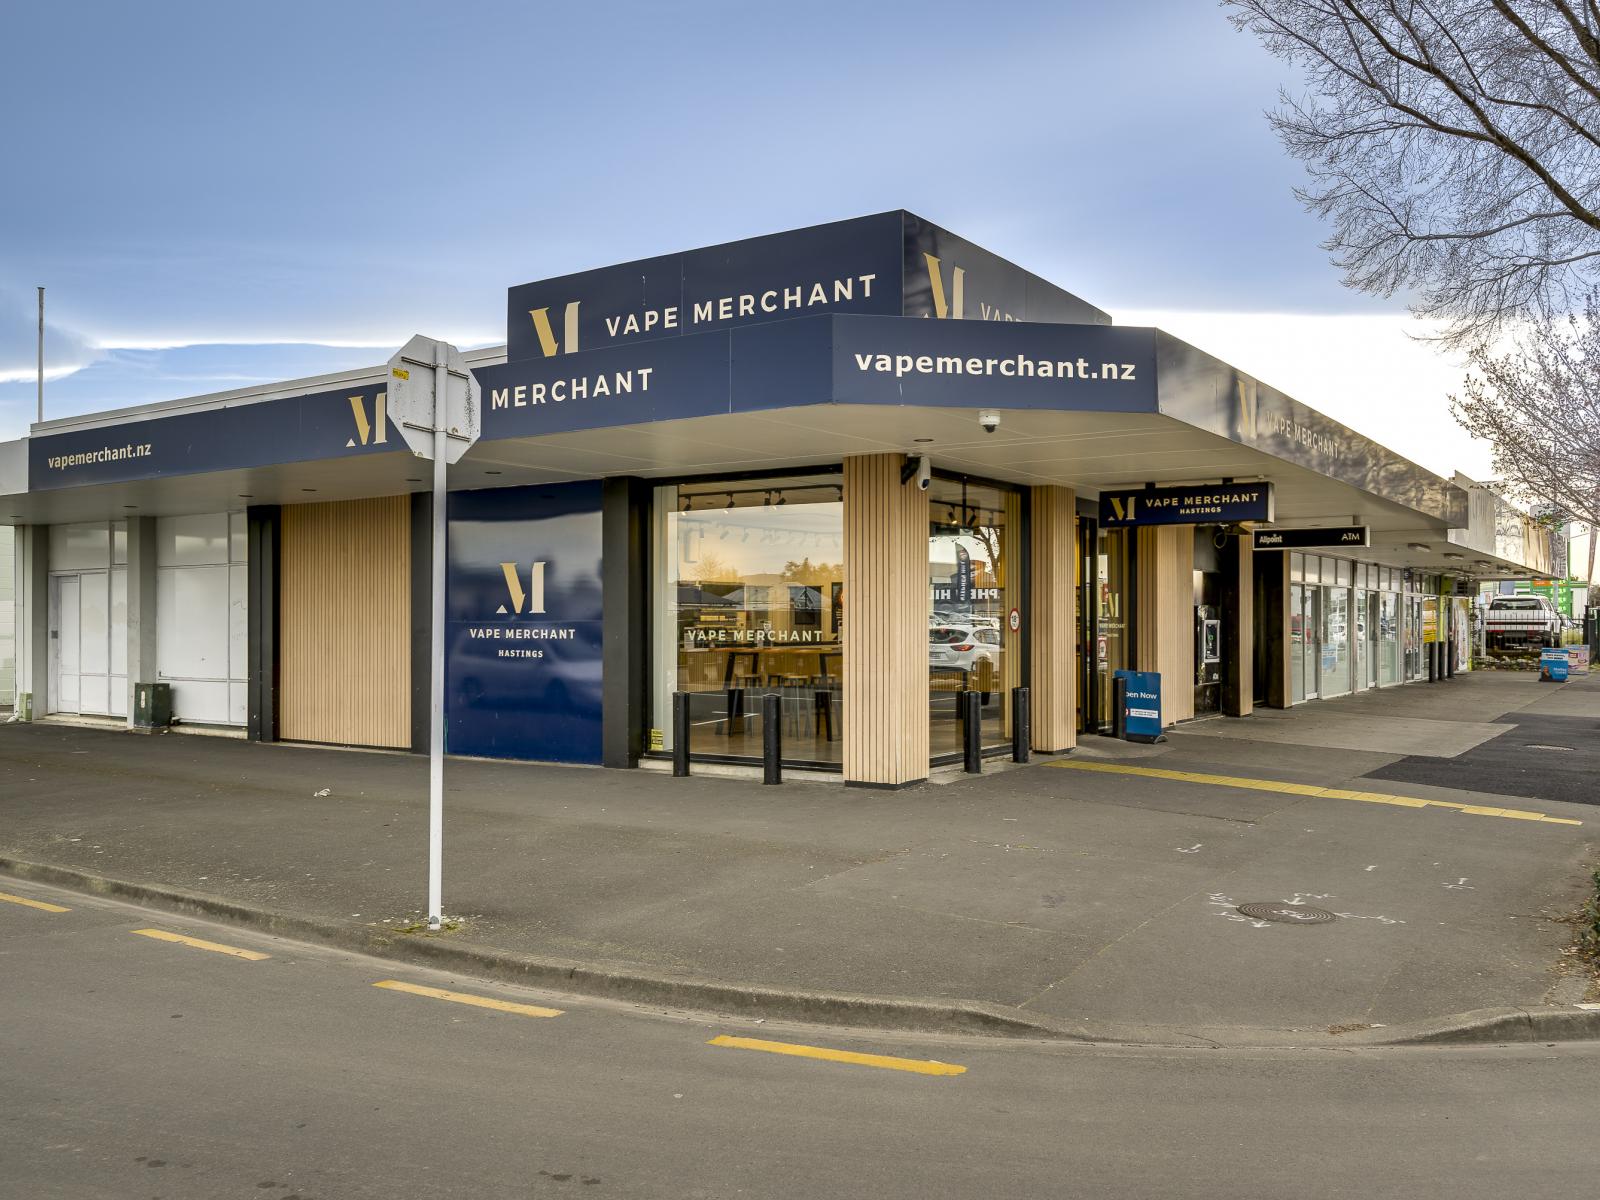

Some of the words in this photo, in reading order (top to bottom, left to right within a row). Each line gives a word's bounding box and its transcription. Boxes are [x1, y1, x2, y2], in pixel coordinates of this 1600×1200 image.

[605, 306, 679, 337] VAPE
[693, 273, 876, 325] MERCHANT
[854, 353, 1136, 381] vapemerchant.nz
[491, 367, 654, 411] MERCHANT
[1266, 410, 1292, 438] VAPE
[1294, 423, 1340, 459] MERCHANT
[48, 441, 152, 472] vapemerchant.nz
[1145, 497, 1179, 508] VAPE
[1184, 493, 1259, 506] MERCHANT
[1179, 506, 1222, 515] HASTINGS
[1258, 534, 1283, 545] Allpoint
[1341, 532, 1360, 542] ATM
[470, 627, 501, 640] VAPE
[505, 627, 577, 640] MERCHANT
[687, 629, 727, 642] VAPE
[733, 629, 824, 643] MERCHANT
[498, 648, 544, 659] HASTINGS
[1140, 692, 1158, 700] Now
